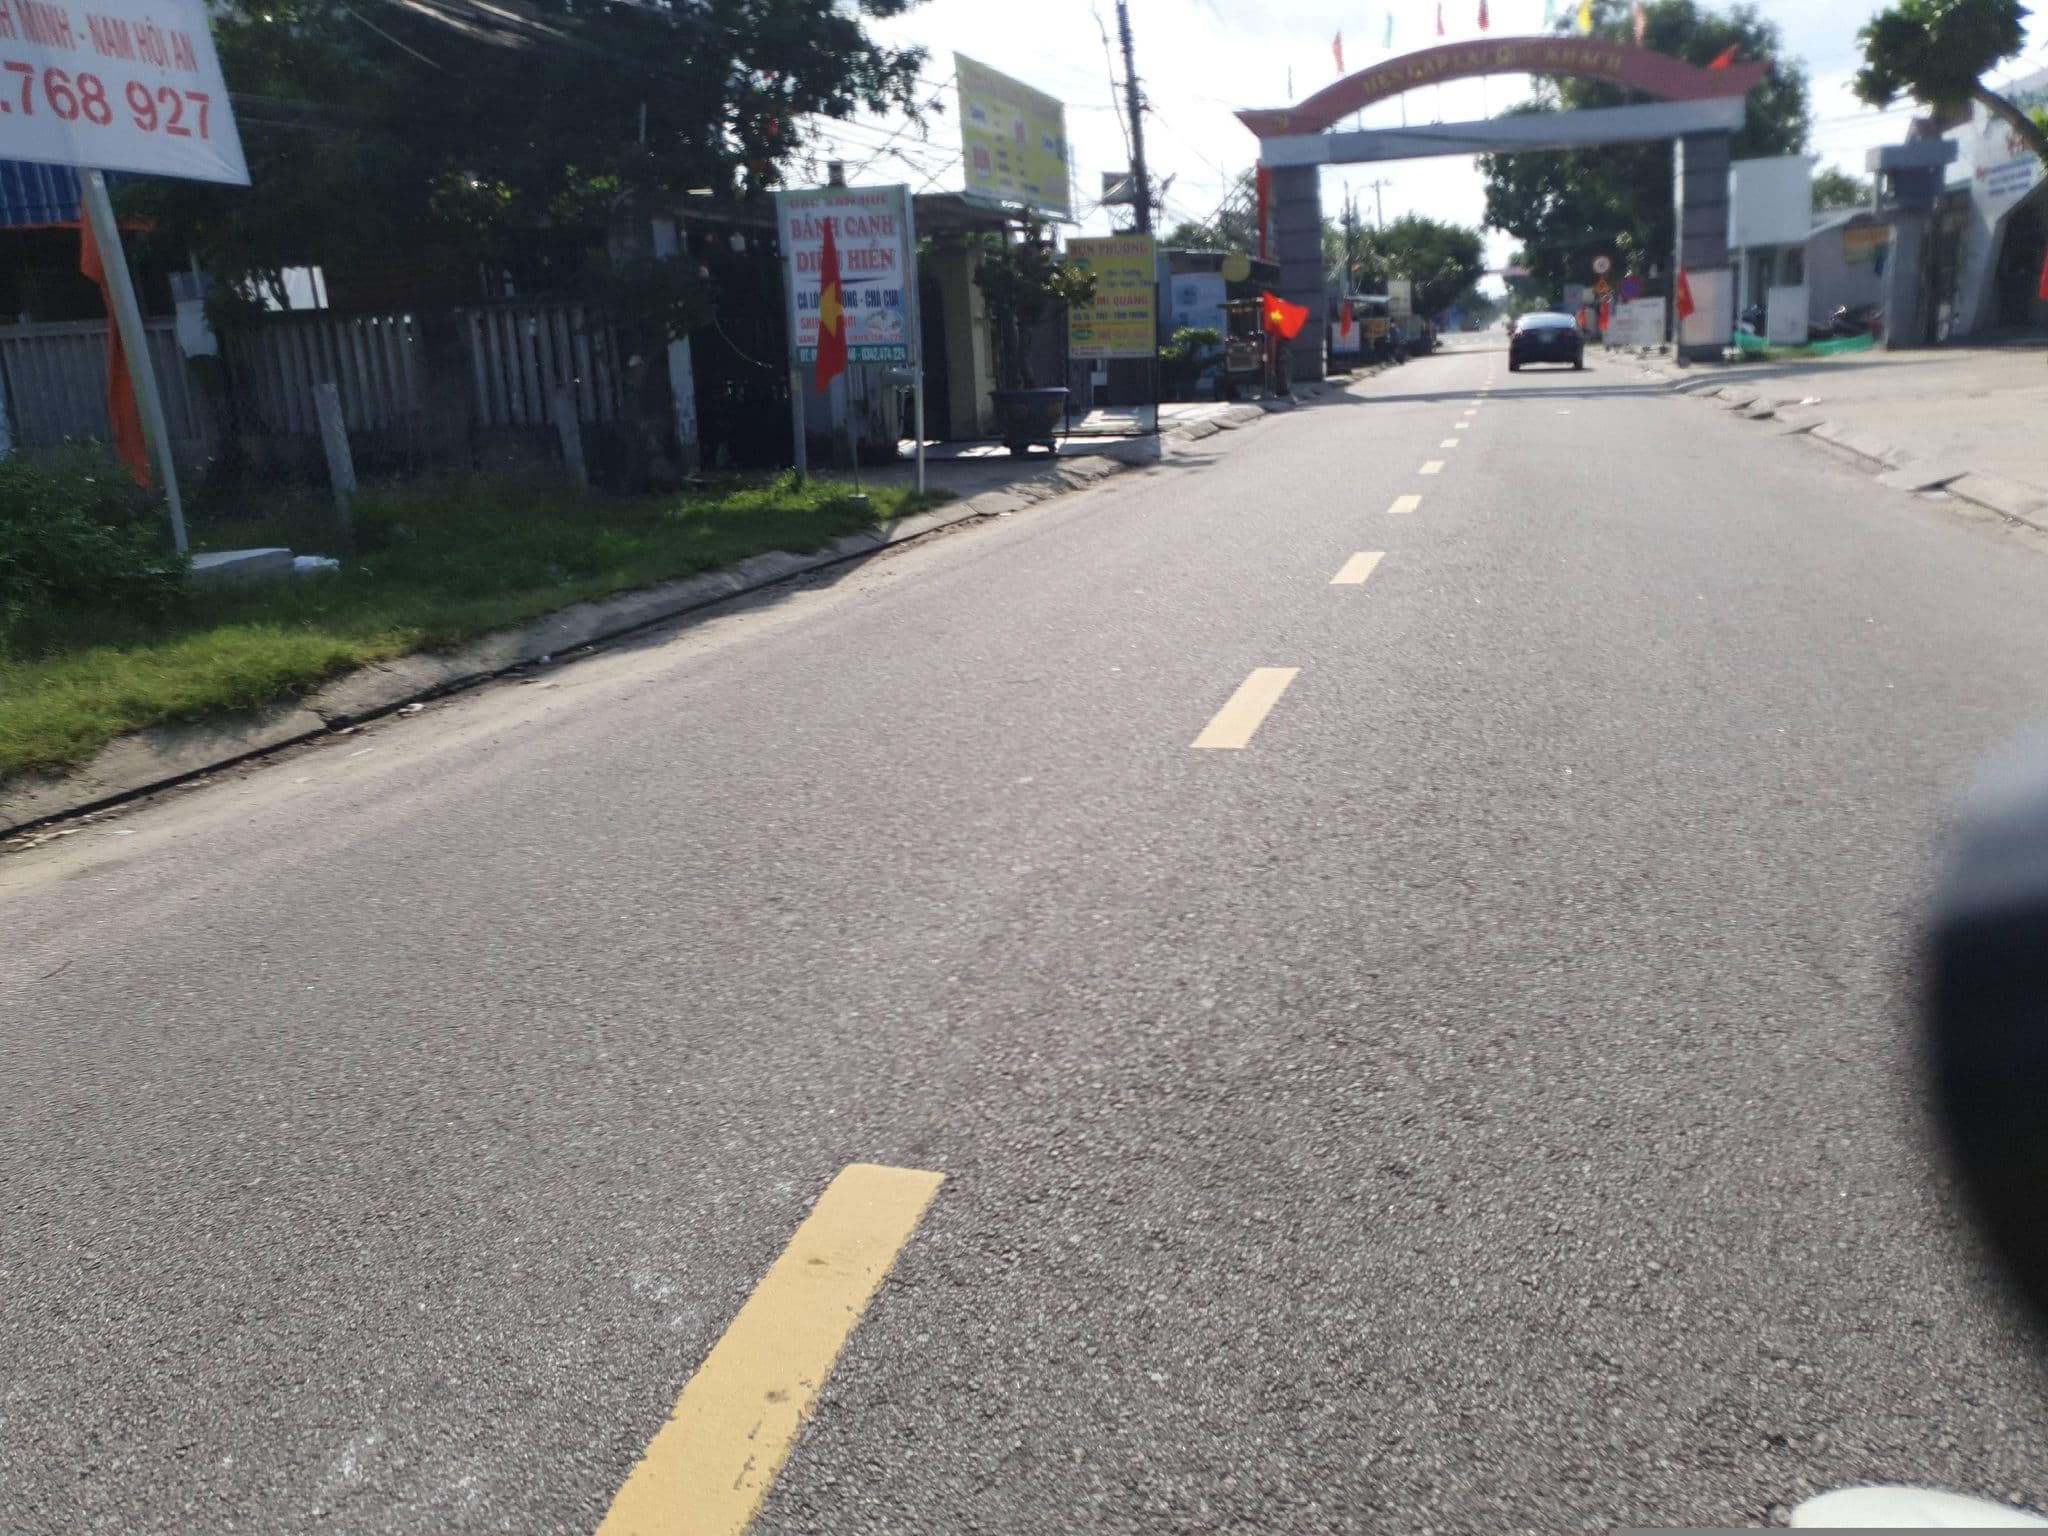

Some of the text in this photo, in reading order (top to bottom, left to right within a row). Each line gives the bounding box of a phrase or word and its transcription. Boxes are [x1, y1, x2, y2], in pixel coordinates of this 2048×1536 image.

[86, 13, 136, 60] NAM
[169, 31, 199, 72] AN
[125, 80, 210, 139] 927
[844, 216, 895, 236] CANH
